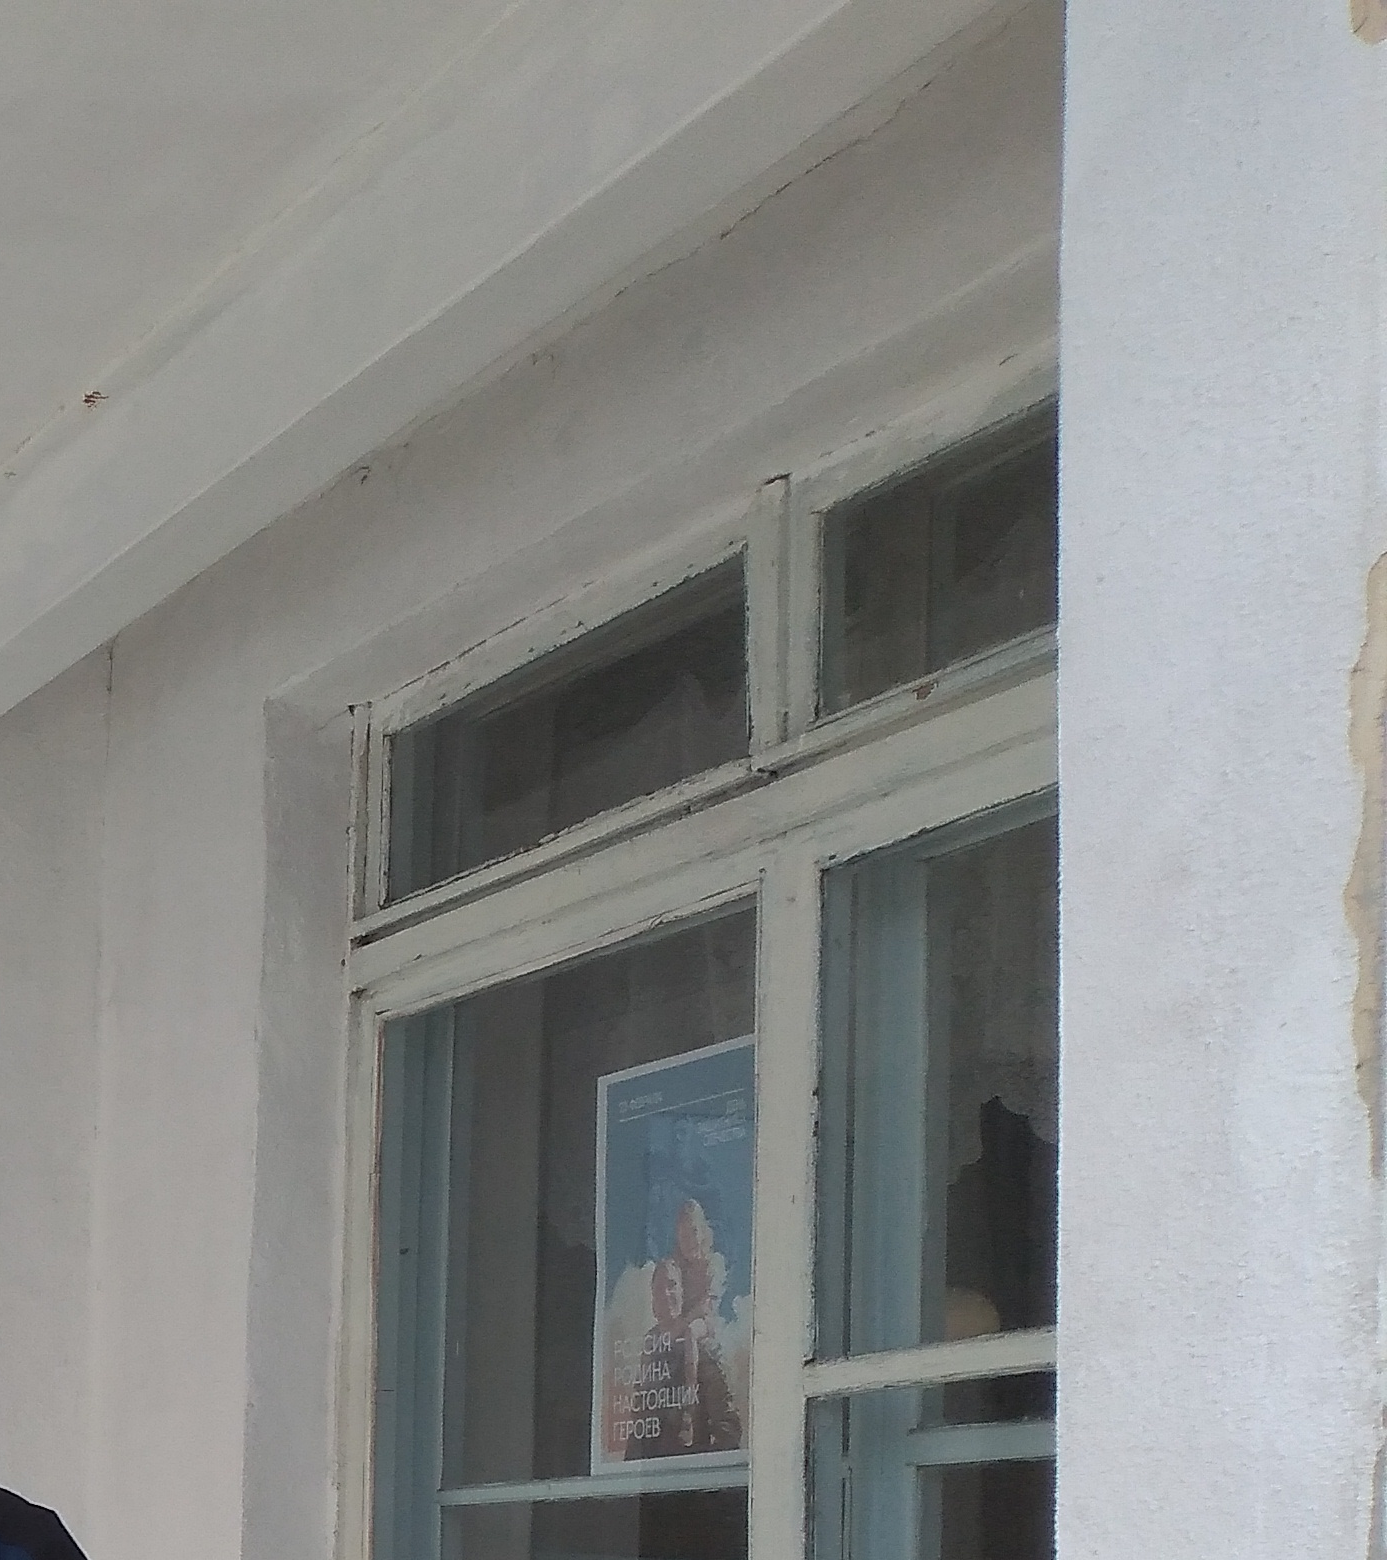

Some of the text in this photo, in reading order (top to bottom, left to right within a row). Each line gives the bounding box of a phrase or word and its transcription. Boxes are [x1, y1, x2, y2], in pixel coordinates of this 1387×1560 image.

[613, 1361, 672, 1387] РОДИНА
[613, 1384, 701, 1414] НАСТОЯЩИХ
[612, 1417, 661, 1441] ГЕРОЕВ
